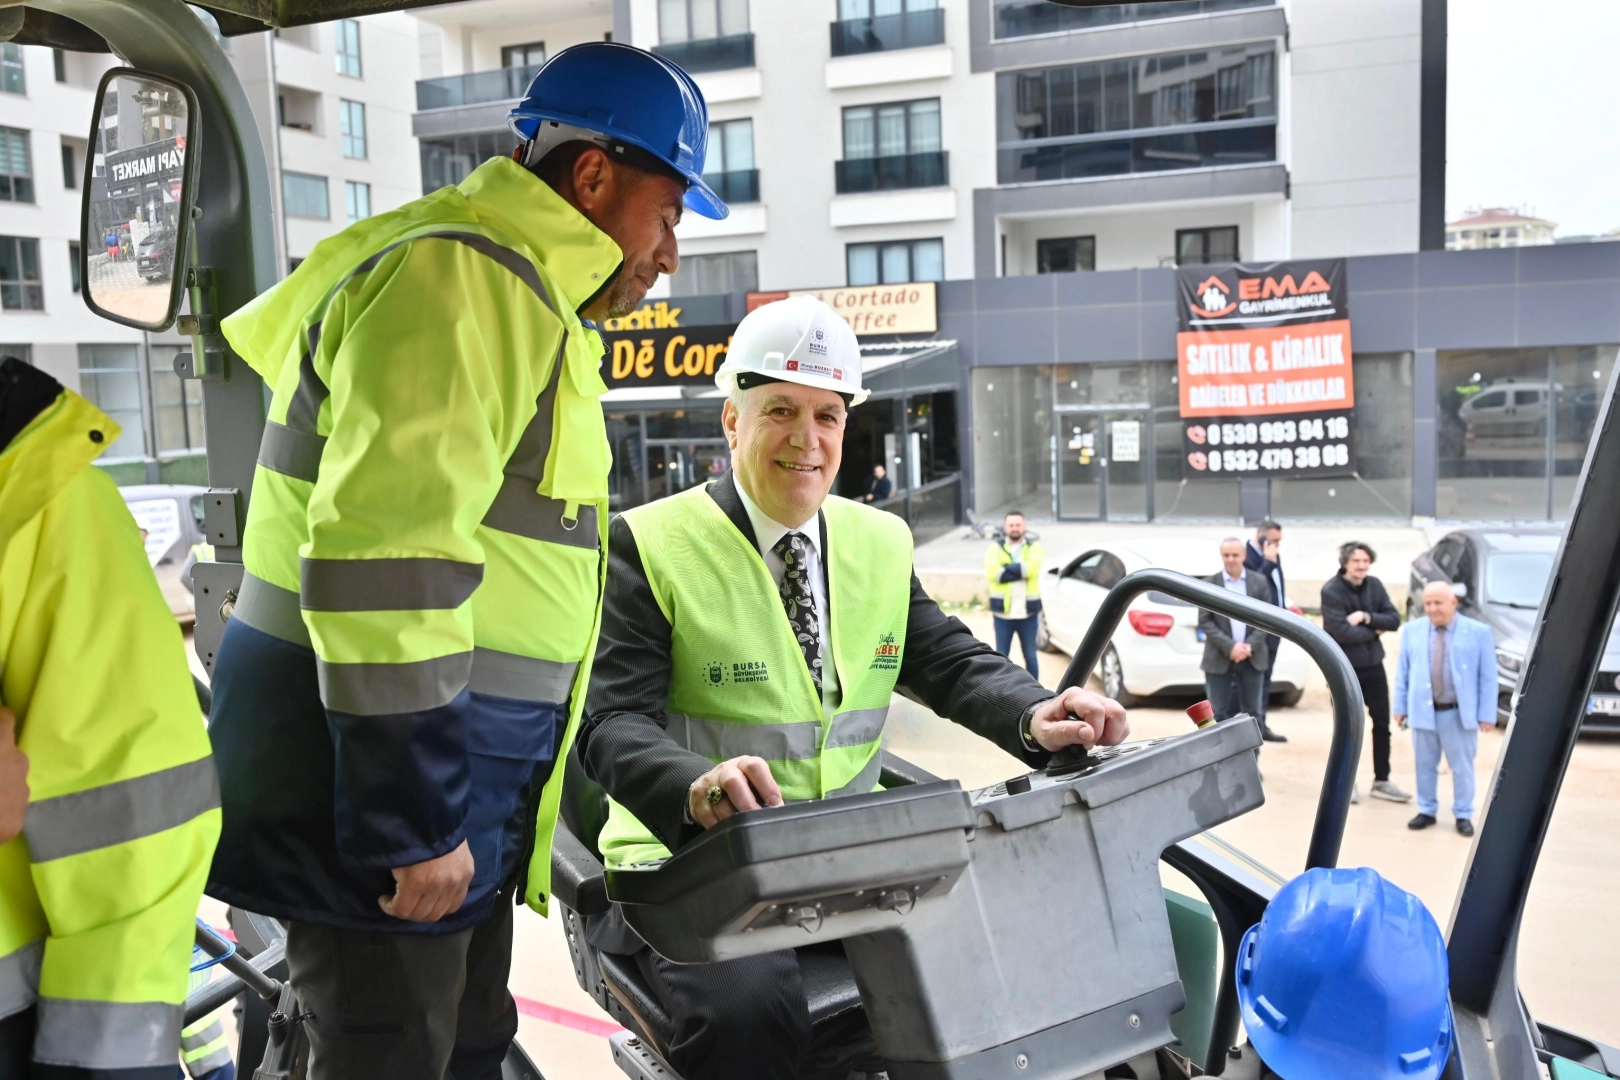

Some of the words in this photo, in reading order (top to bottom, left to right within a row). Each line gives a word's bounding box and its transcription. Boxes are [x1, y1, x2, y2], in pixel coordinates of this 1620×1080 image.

[1239, 270, 1331, 300] EMA
[833, 288, 920, 308] Cortado
[1186, 343, 1251, 375] SATILIK
[1255, 346, 1269, 371] &
[1272, 334, 1344, 371] KİRALIK
[1249, 383, 1265, 406] VE
[1207, 424, 1221, 445] 0
[1222, 423, 1258, 445] 530
[1259, 420, 1297, 443] 993
[1299, 419, 1324, 441] 94
[1325, 416, 1349, 438] 16
[1208, 450, 1222, 472] 0
[1223, 449, 1259, 471] 532
[1260, 448, 1293, 470] 479
[733, 661, 767, 671] BURSA
[734, 669, 767, 677] BÜYÜKŞEHİR
[734, 675, 769, 683] BELEDİYESİ
